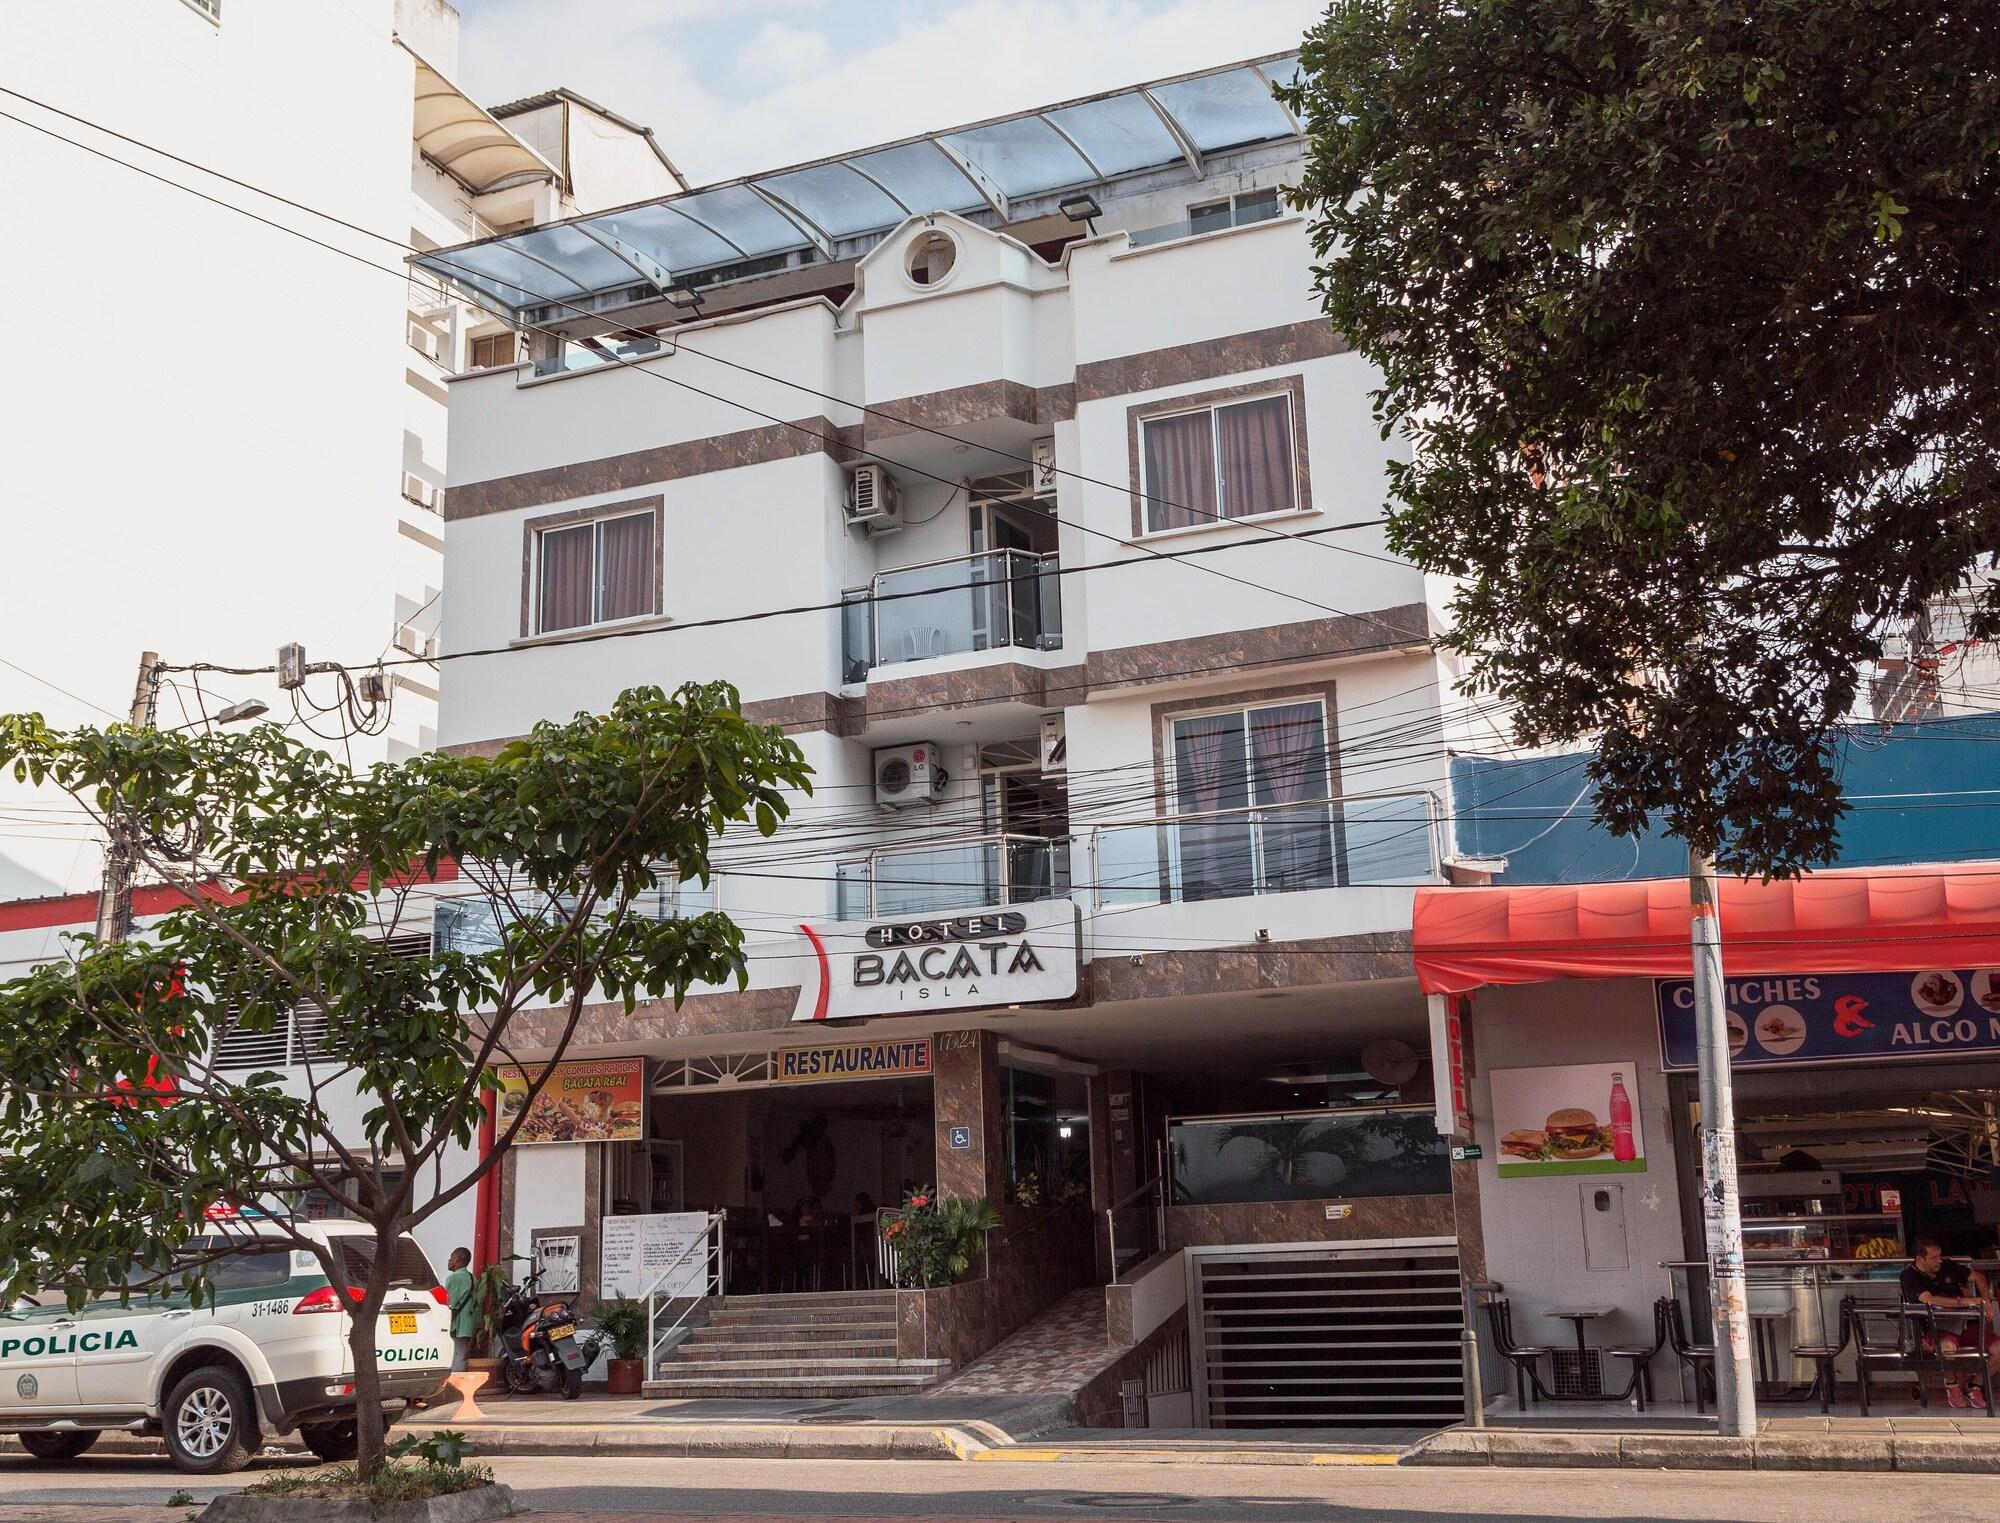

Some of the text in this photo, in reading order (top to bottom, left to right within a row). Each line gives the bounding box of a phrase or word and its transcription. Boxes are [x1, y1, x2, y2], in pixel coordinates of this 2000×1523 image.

[880, 915, 1008, 943] HOTEL
[853, 939, 1045, 987] BACATA
[900, 984, 979, 1001] ISLA
[1673, 978, 1821, 1009] CICHES
[1832, 993, 1876, 1038] &
[1892, 1019, 1977, 1045] ALGO
[566, 1064, 603, 1076] COMIDAS
[603, 1062, 640, 1074] RAPIDAS
[784, 1042, 927, 1077] RESTAURANTE
[563, 1075, 629, 1091] BACATA REAL
[252, 1300, 289, 1318] 31-1486
[1, 1329, 138, 1358] POLICIA
